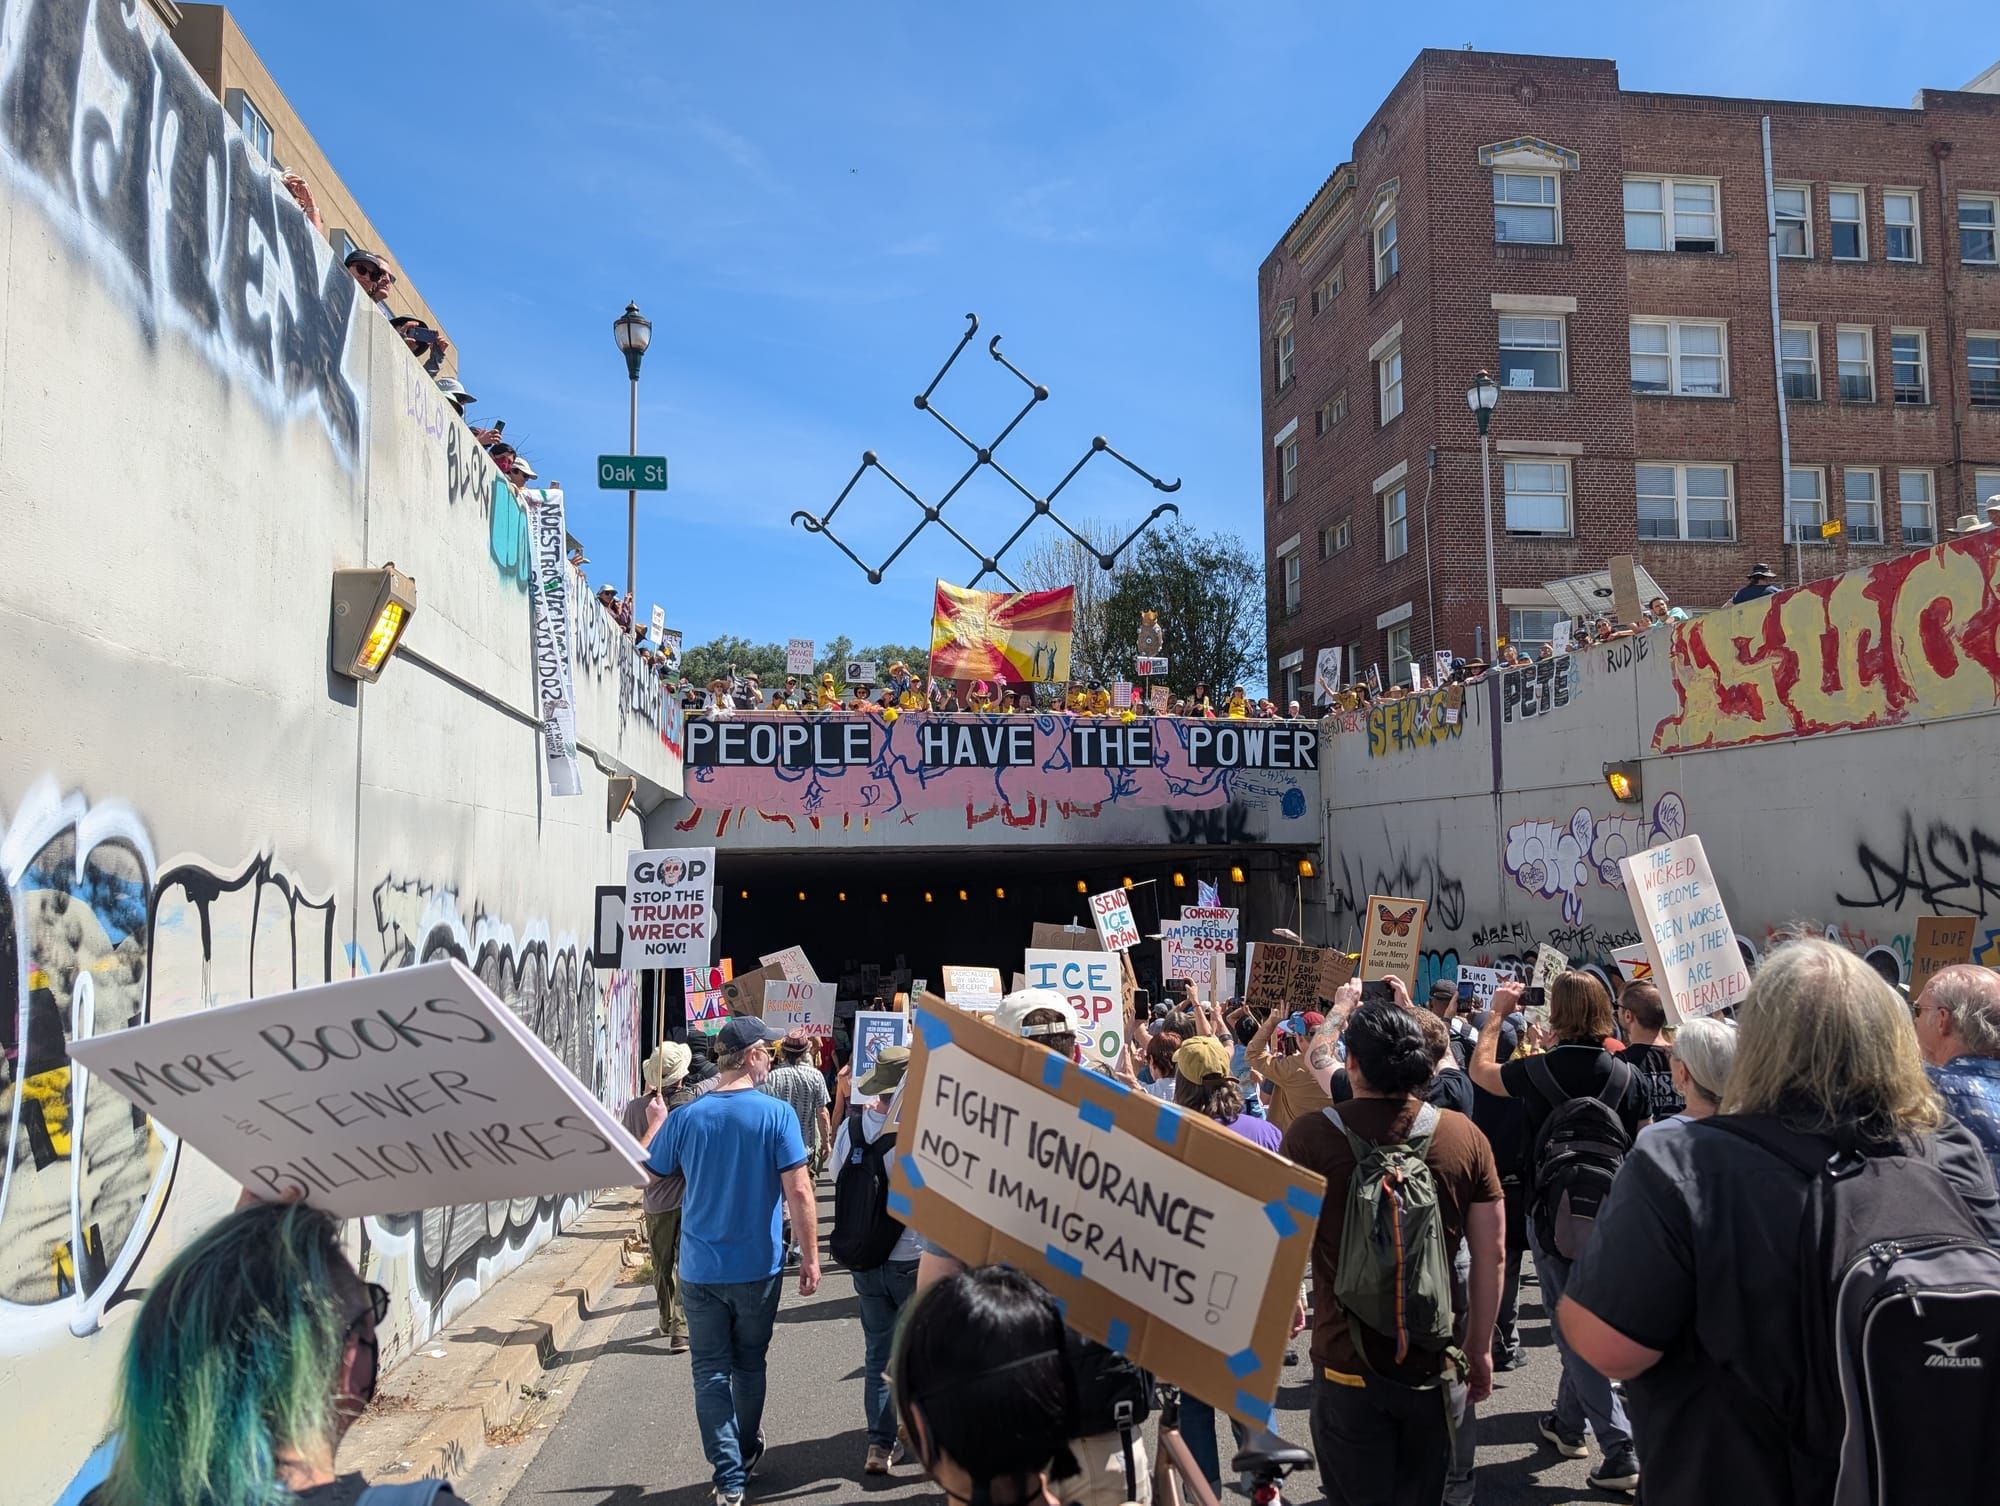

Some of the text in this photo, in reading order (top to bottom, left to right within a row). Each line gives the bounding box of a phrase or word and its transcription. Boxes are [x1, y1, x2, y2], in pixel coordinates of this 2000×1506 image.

[601, 463, 664, 482] Oak St
[788, 640, 814, 649] REMOVE
[788, 648, 813, 657] ORANGE
[1140, 660, 1152, 673] NO
[686, 722, 870, 765] PEOPLE
[924, 725, 1033, 766] HAVE
[1073, 727, 1150, 766] THE
[1190, 728, 1316, 768] POWER
[1649, 847, 1672, 869] THE
[634, 859, 706, 885] GOP
[1644, 857, 1696, 891] WICKED
[633, 889, 704, 903] STOP THE
[1095, 889, 1128, 915] SEND
[1657, 881, 1700, 913] BECOME
[631, 904, 704, 921] TRUMP
[1103, 911, 1130, 930] ICE
[1184, 907, 1234, 922] CORONARY
[628, 922, 704, 940] WRECK
[1115, 927, 1124, 935] TO
[1201, 920, 1220, 928] FOR
[1655, 918, 1683, 944] EVEN
[1688, 902, 1724, 930] WORSE
[1106, 930, 1138, 951] IRAN
[1194, 937, 1234, 952] 2026
[1387, 940, 1407, 949] Justice
[1931, 929, 1967, 947] LOVE
[645, 942, 686, 955] NOW!
[1263, 945, 1287, 960] NO
[1295, 947, 1320, 963] YES
[1373, 949, 1408, 960] Love Mercy
[1664, 927, 1729, 969] WHEN THEY
[1264, 961, 1288, 975] WAR
[1369, 959, 1410, 970] Walk Humbly
[692, 967, 724, 992] NO
[1030, 962, 1112, 991] ICE
[1262, 975, 1285, 986] ICE
[1688, 960, 1713, 988] ARE
[787, 983, 813, 999] NO
[1675, 971, 1746, 1015] TOLERATED
[1067, 994, 1113, 1023] BP
[788, 1012, 811, 1024] ICE
[801, 1024, 831, 1034] WAR
[108, 997, 497, 1107] MORE BOOKS
[258, 1069, 498, 1135] FEWER
[251, 1115, 613, 1200] BILLIONAIRES
[920, 1129, 981, 1180] NOT
[935, 1073, 1214, 1249] FIGHT IGNORANCE
